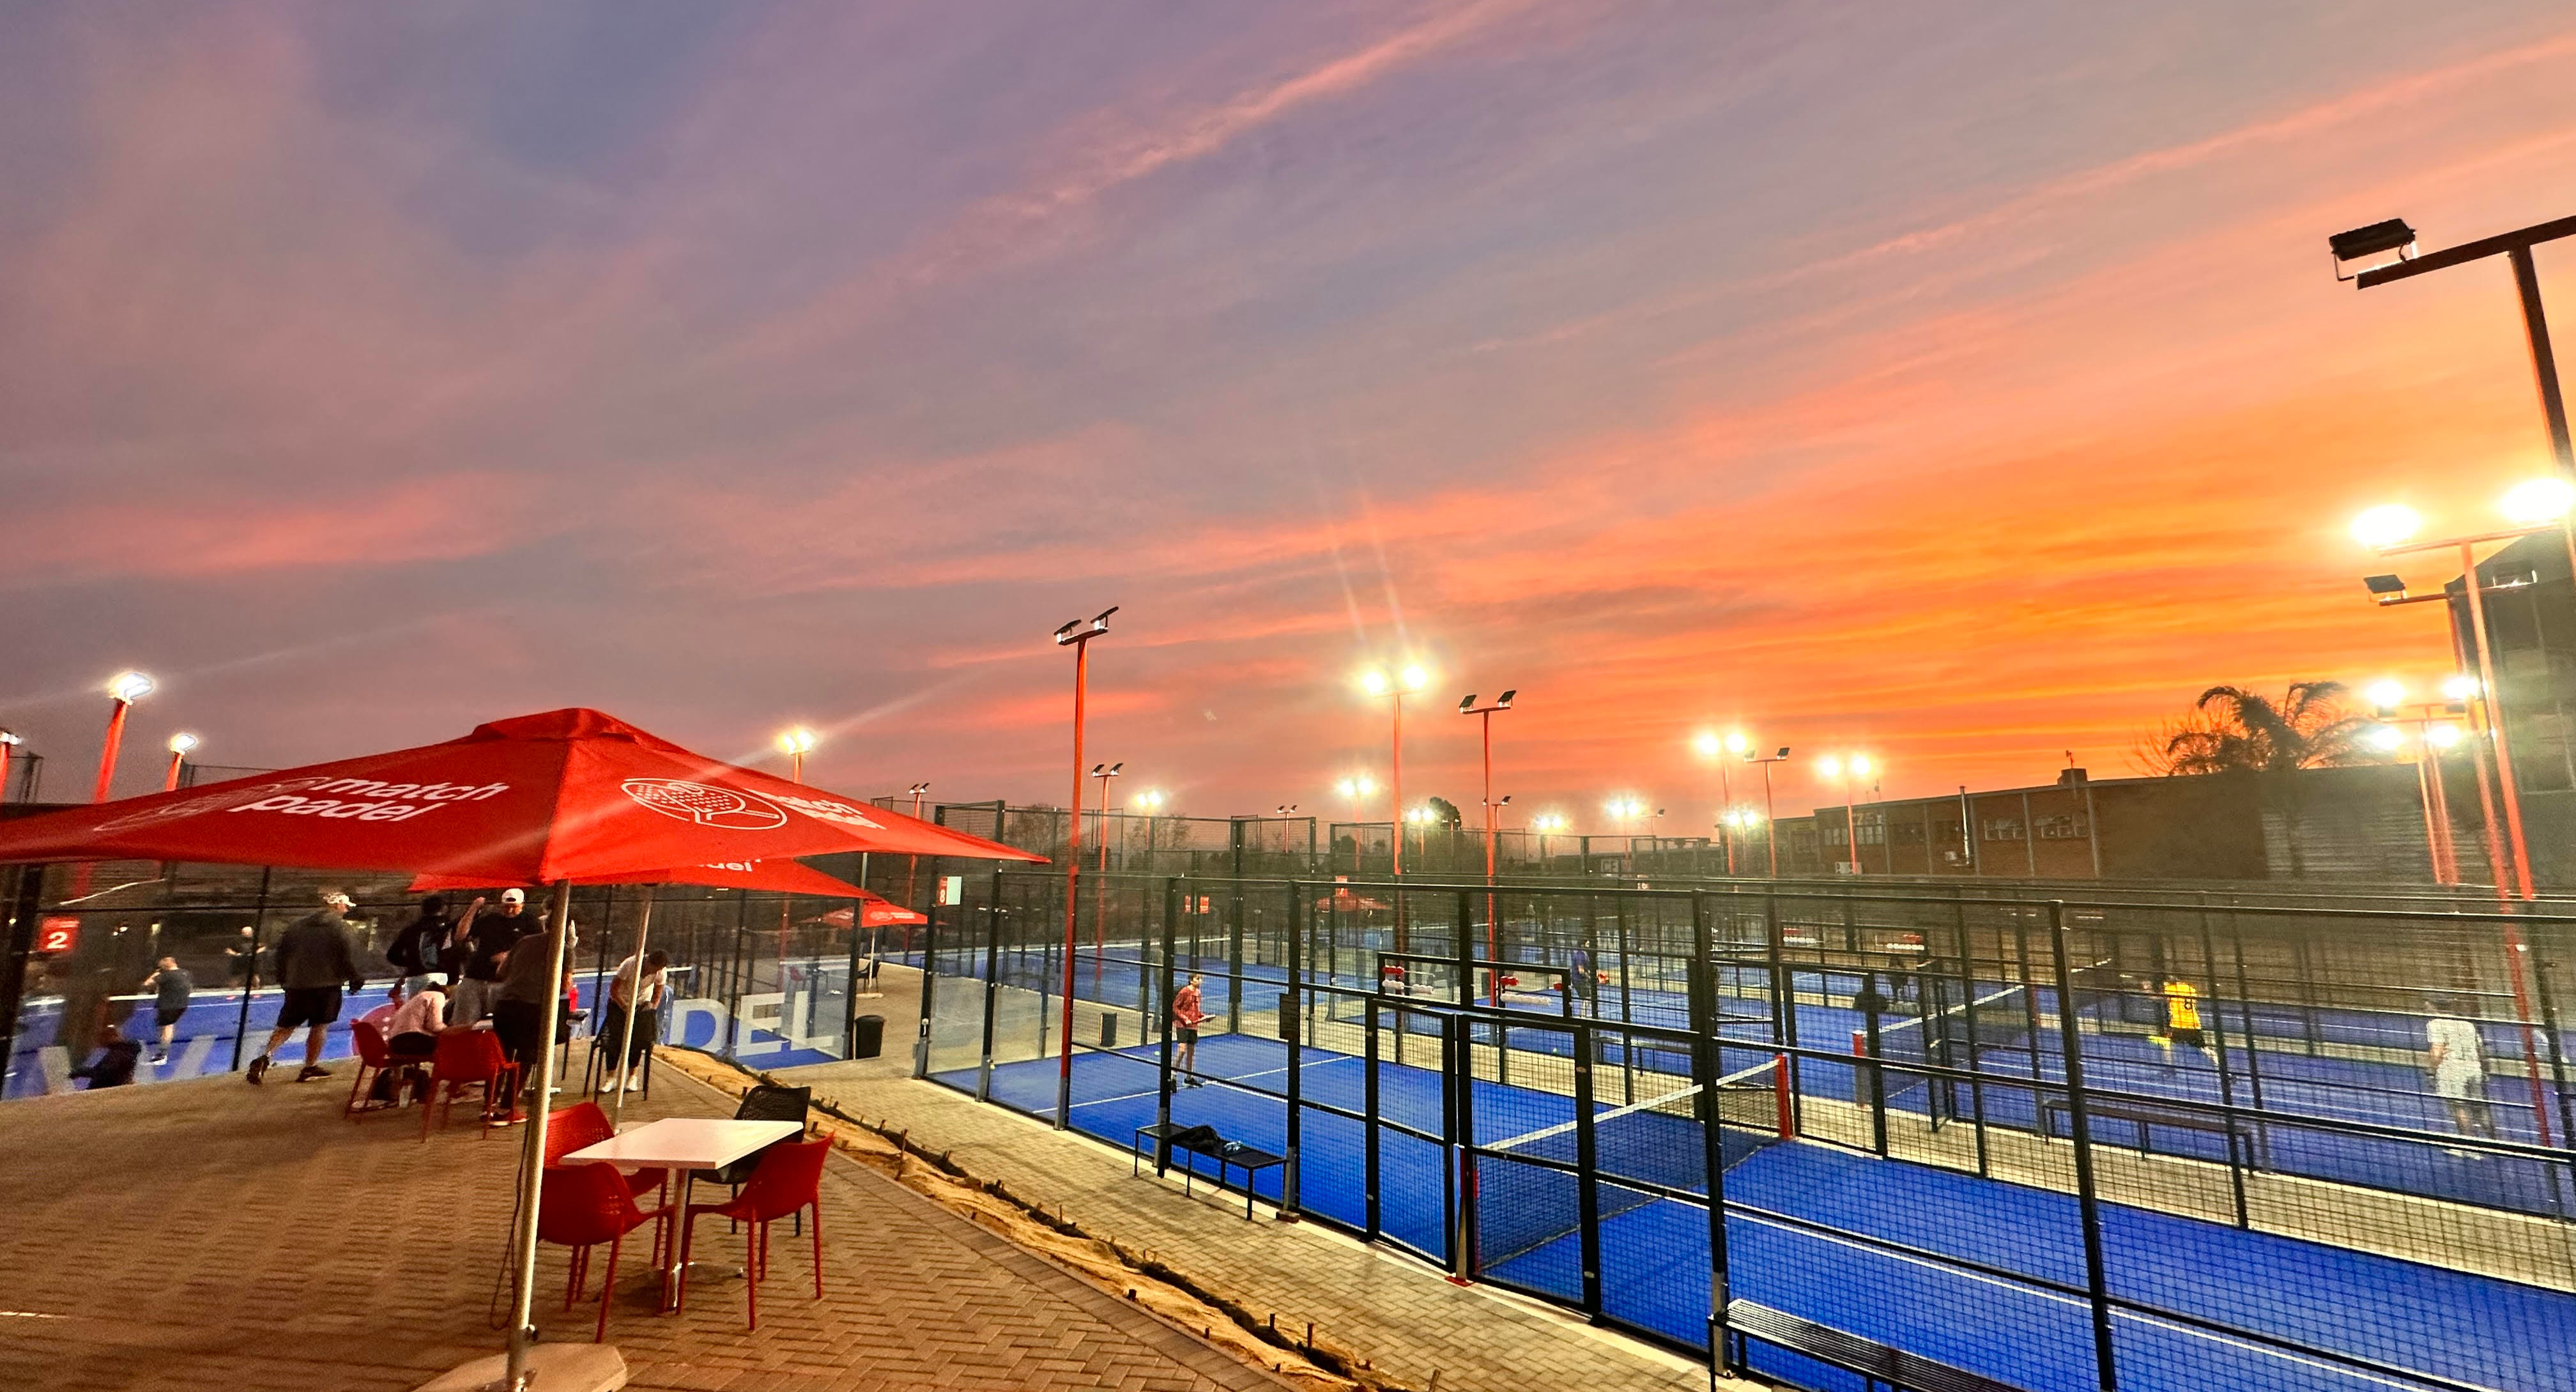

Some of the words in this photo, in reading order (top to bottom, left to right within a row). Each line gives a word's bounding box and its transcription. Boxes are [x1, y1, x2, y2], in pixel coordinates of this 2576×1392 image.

[308, 778, 509, 800] match
[226, 795, 447, 822] padel
[940, 889, 946, 903] 8
[47, 931, 68, 949] 2
